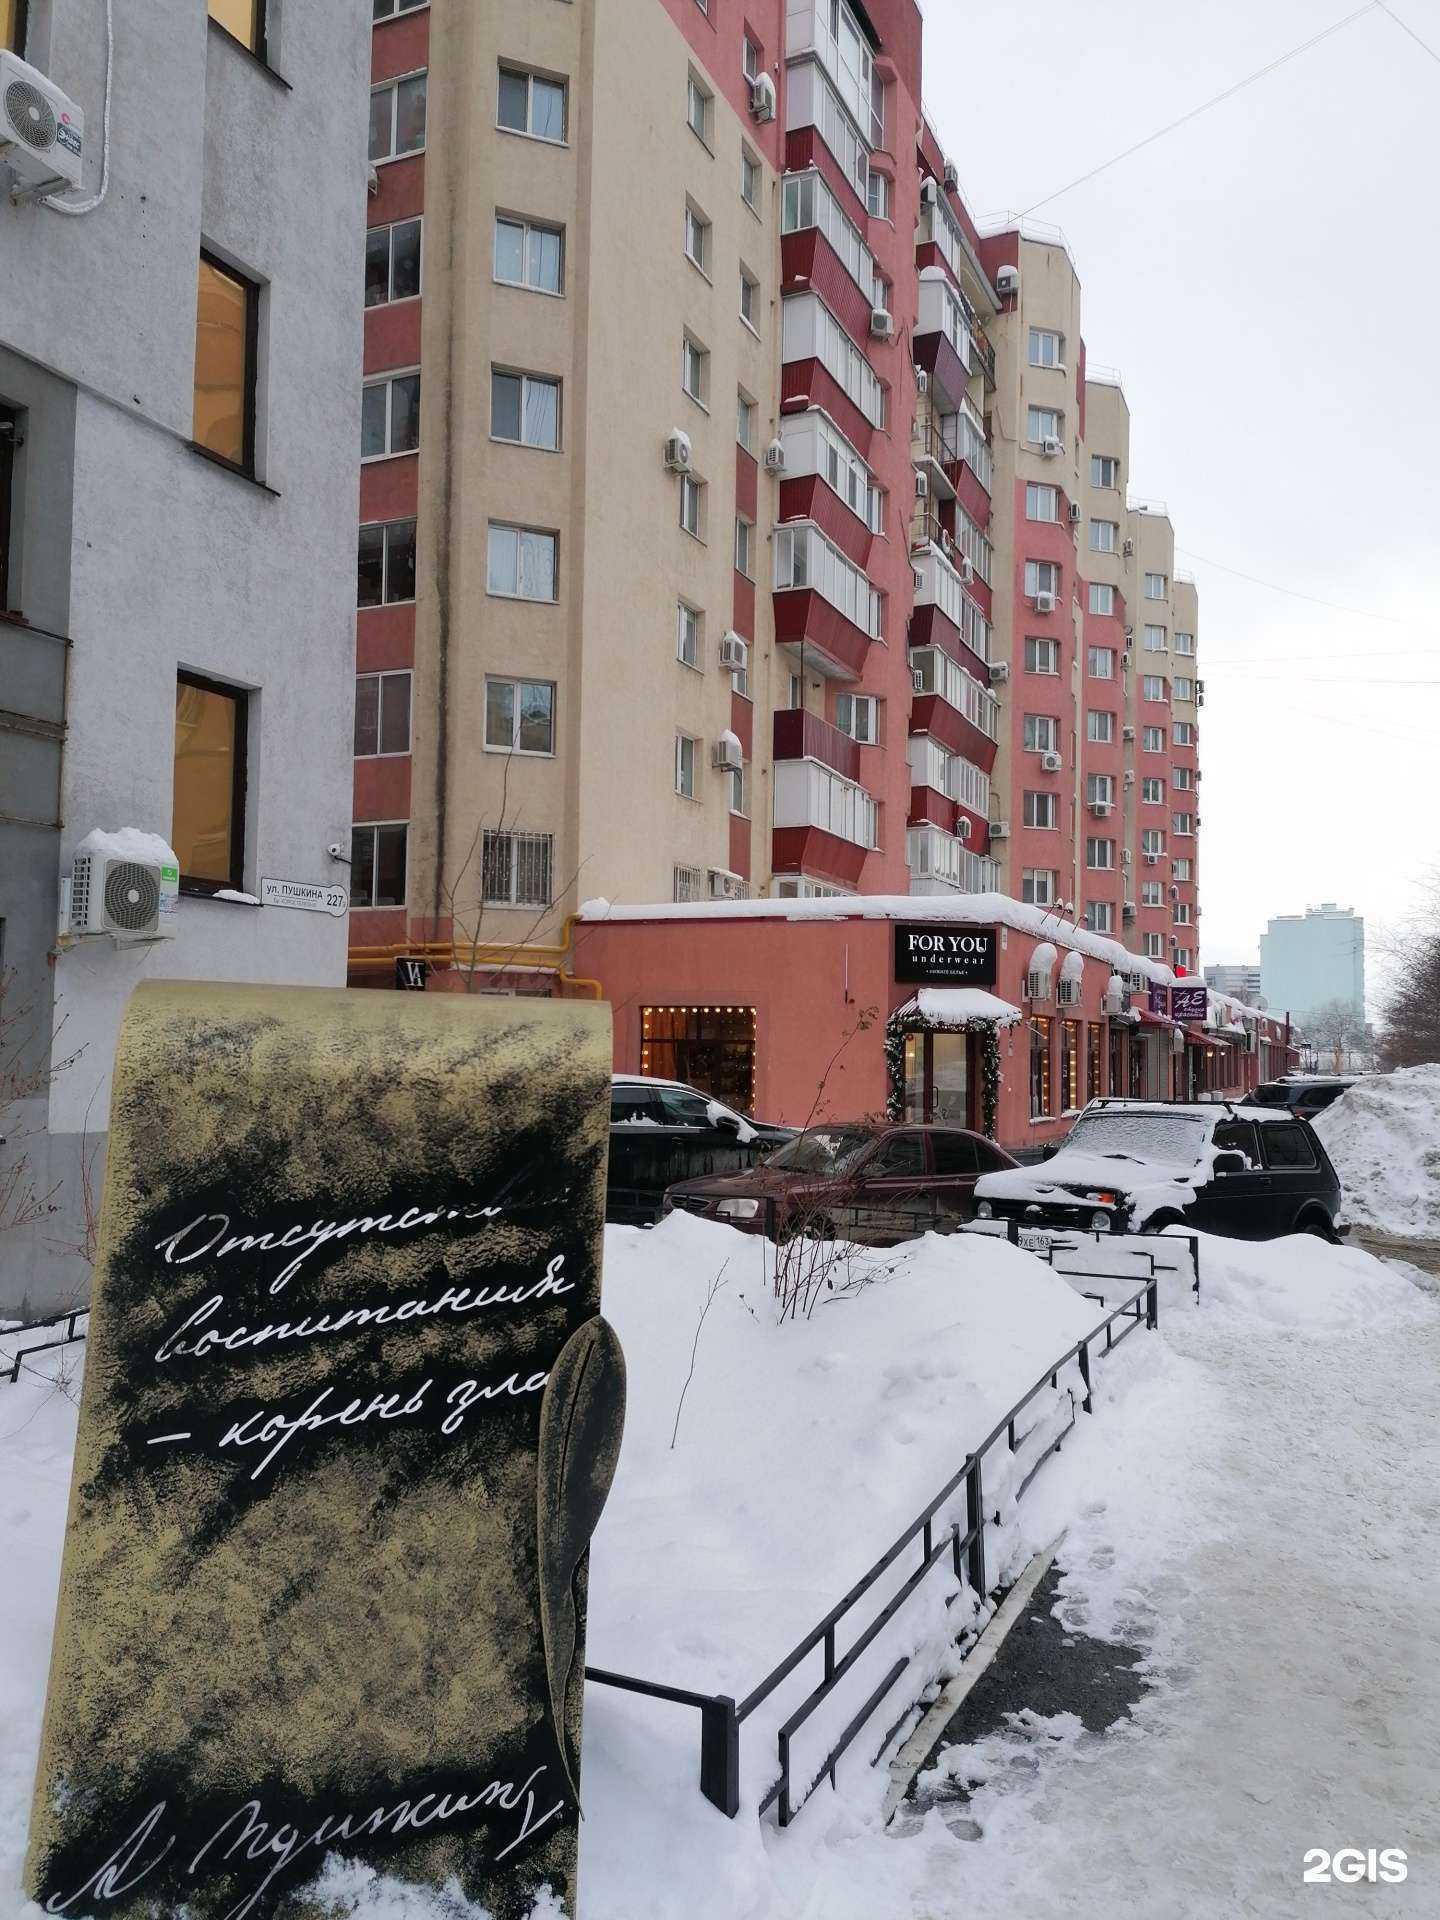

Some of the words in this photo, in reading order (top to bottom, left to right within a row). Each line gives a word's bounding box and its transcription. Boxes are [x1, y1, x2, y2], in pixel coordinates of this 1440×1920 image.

[266, 885, 280, 895] ул.
[282, 885, 323, 899] ПУШКИНА
[326, 893, 344, 907] 227
[908, 934, 946, 952] FOR
[948, 936, 988, 953] YOU
[912, 954, 985, 966] underwear
[1036, 1236, 1050, 1247] 163
[218, 1380, 425, 1480] корень
[440, 1370, 552, 1435] зла
